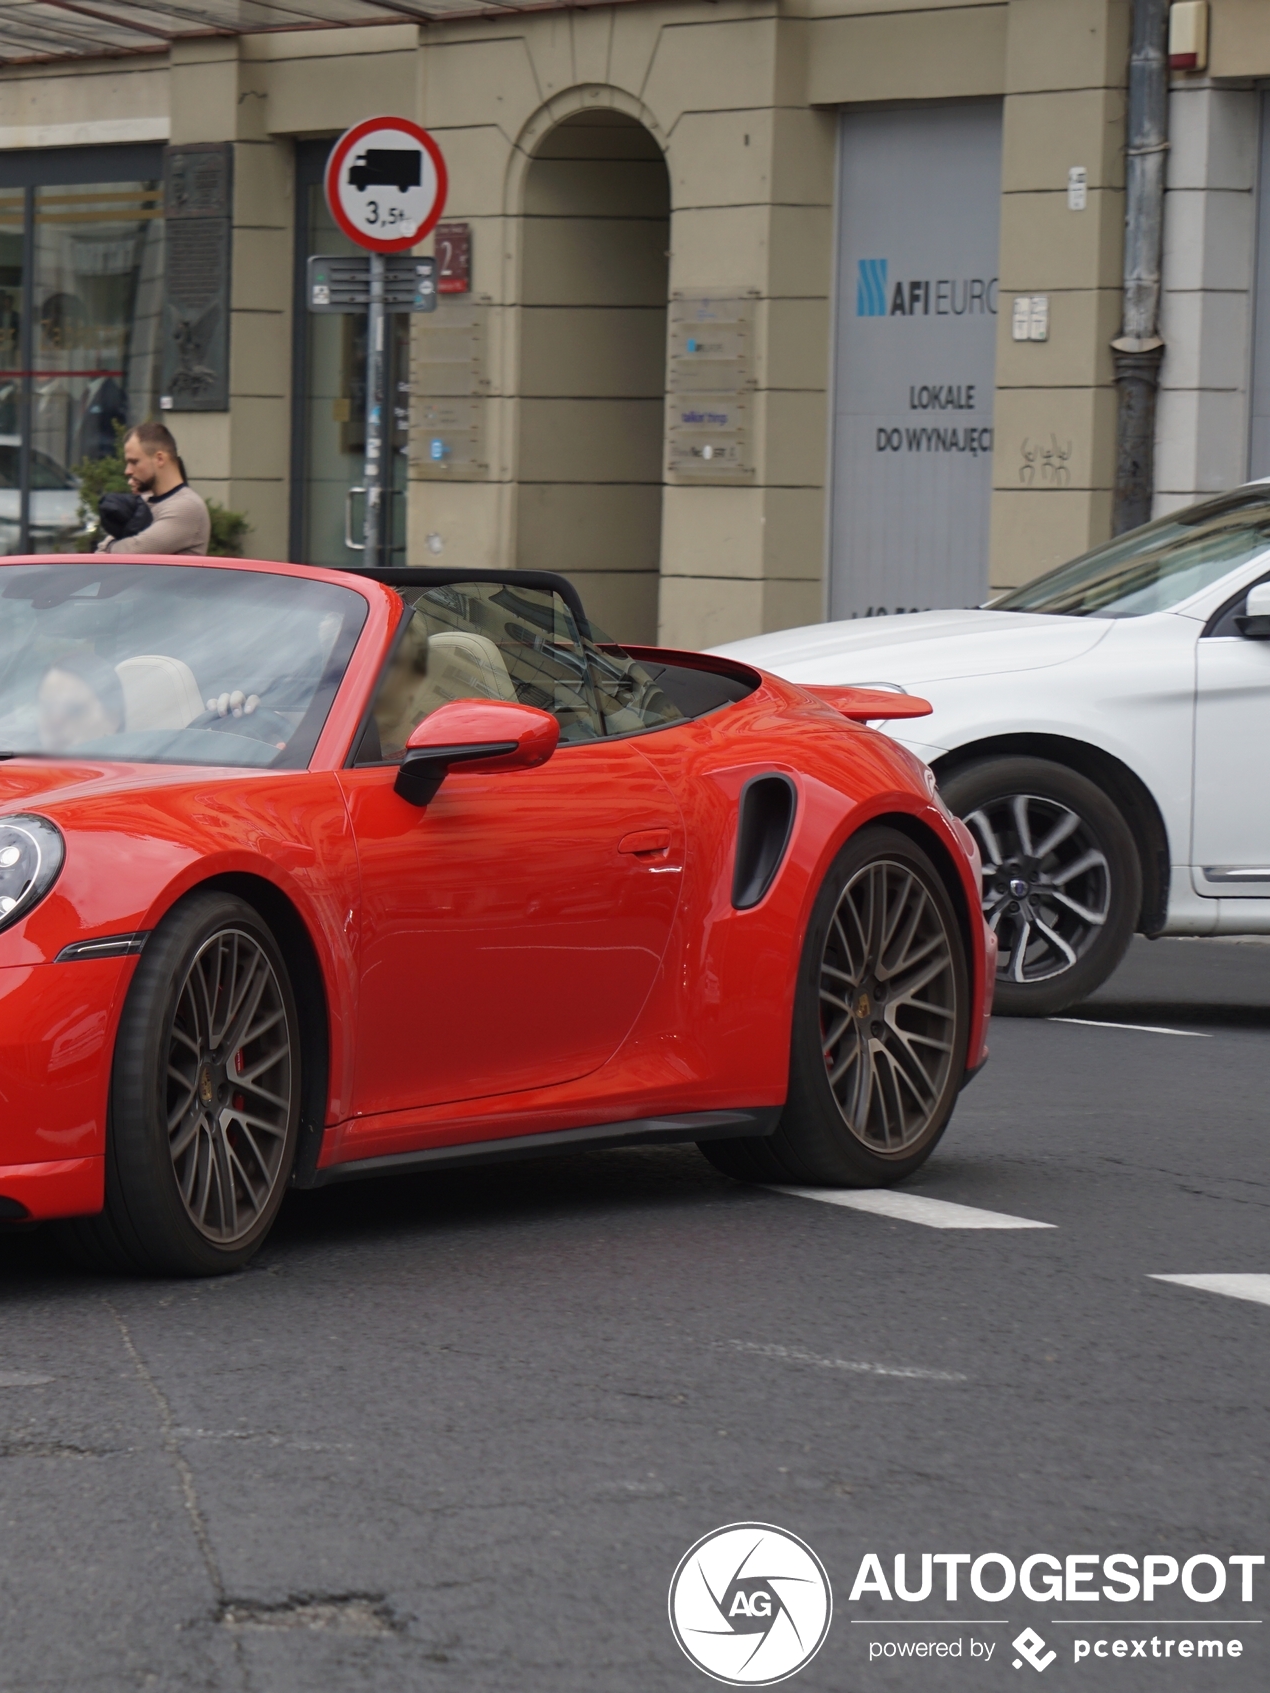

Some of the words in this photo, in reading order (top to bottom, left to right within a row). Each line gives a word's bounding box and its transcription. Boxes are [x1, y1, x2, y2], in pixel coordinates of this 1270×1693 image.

[365, 200, 405, 228] 3,5t
[440, 241, 453, 276] 2
[889, 280, 929, 316] AFI
[909, 385, 976, 410] LOKALE
[876, 427, 902, 452] DO
